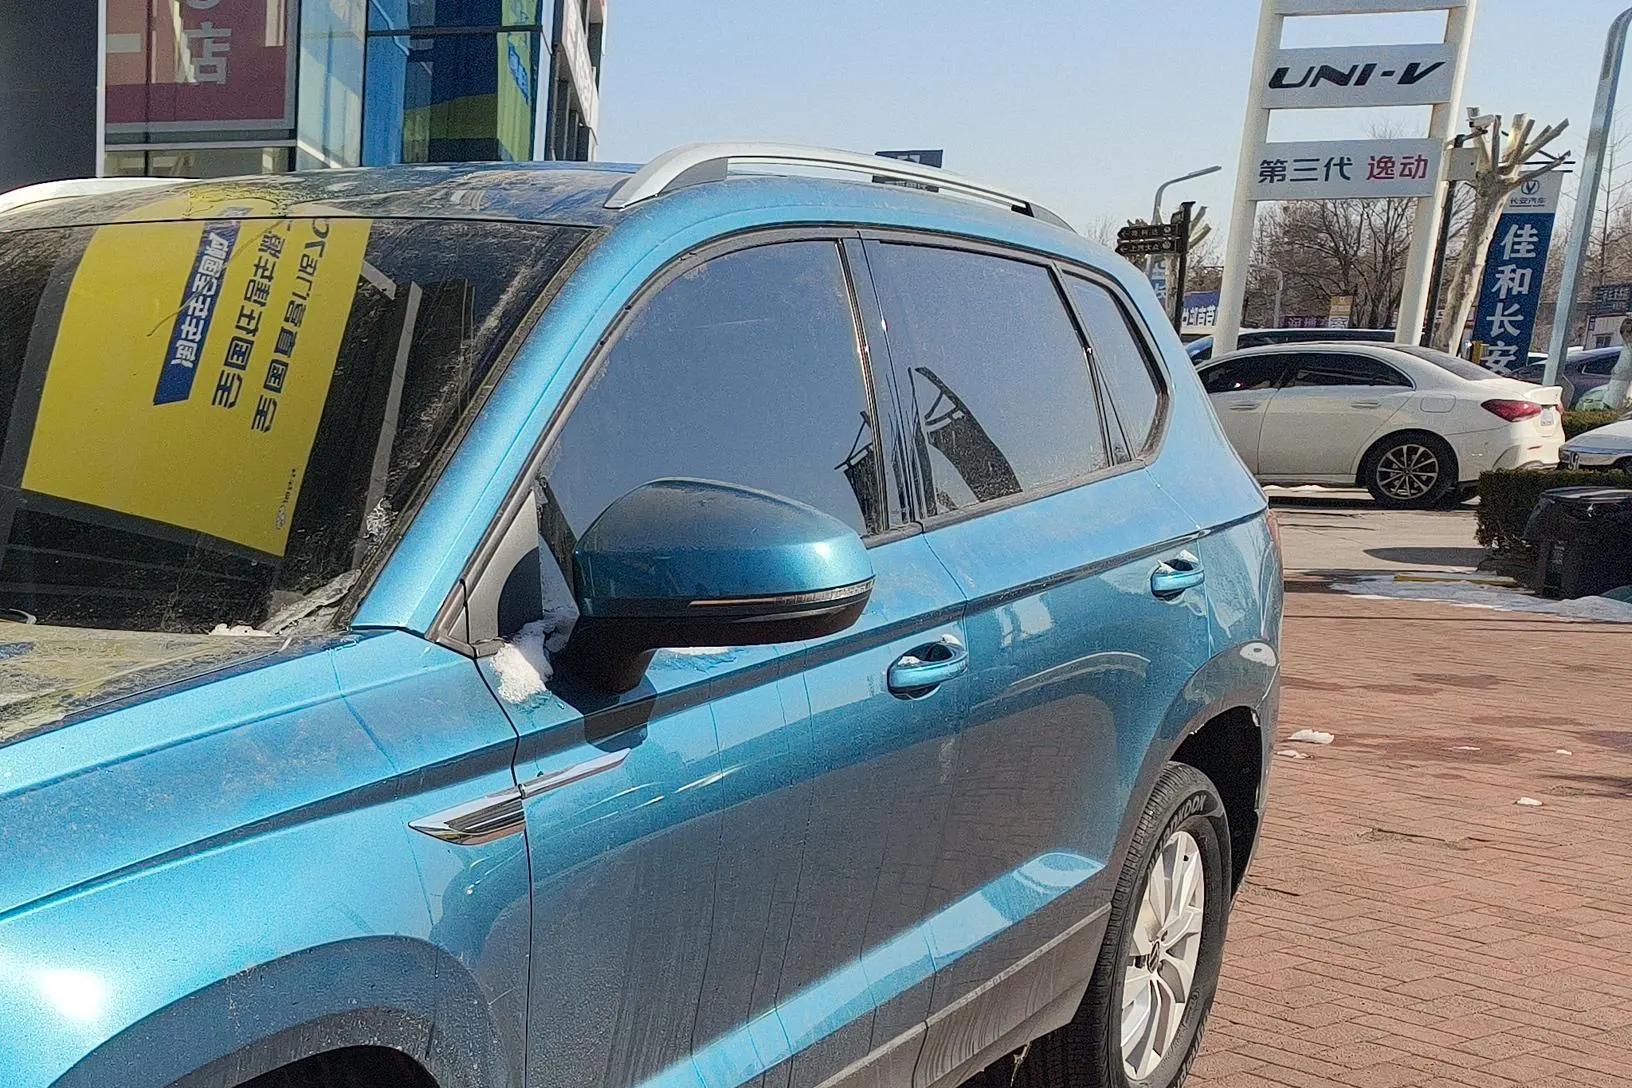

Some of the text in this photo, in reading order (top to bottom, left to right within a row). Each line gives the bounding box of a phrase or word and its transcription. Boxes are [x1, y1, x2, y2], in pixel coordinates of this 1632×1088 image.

[1268, 61, 1446, 89] UNI-V
[1258, 154, 1429, 183] 第三代 逸动
[1480, 224, 1539, 374] 佳和长安
